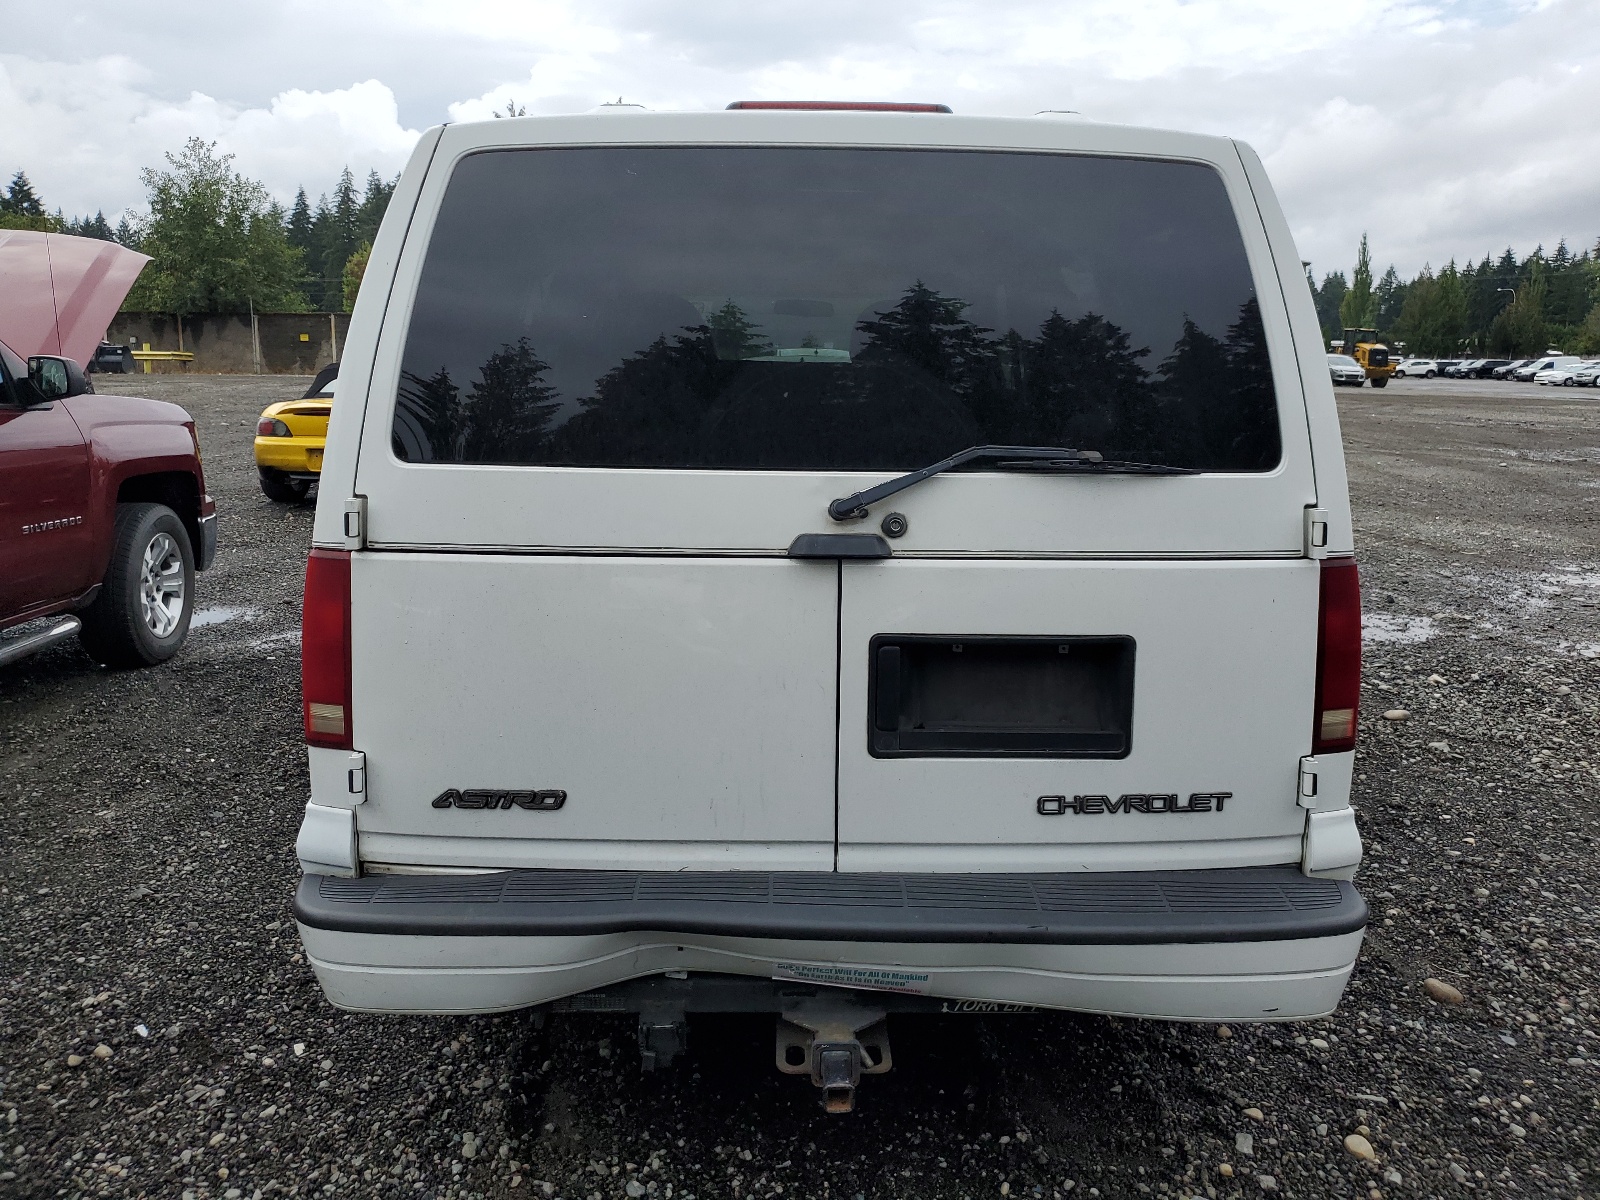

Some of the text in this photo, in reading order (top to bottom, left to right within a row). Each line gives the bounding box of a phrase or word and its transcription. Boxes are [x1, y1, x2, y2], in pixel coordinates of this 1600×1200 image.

[22, 515, 83, 535] SILVERADO
[432, 789, 567, 810] ASTRO
[1037, 792, 1232, 815] CHEVROLET
[801, 966, 833, 974] Perfect
[834, 968, 852, 976] Will
[853, 969, 867, 977] For
[891, 973, 929, 982] Mankind
